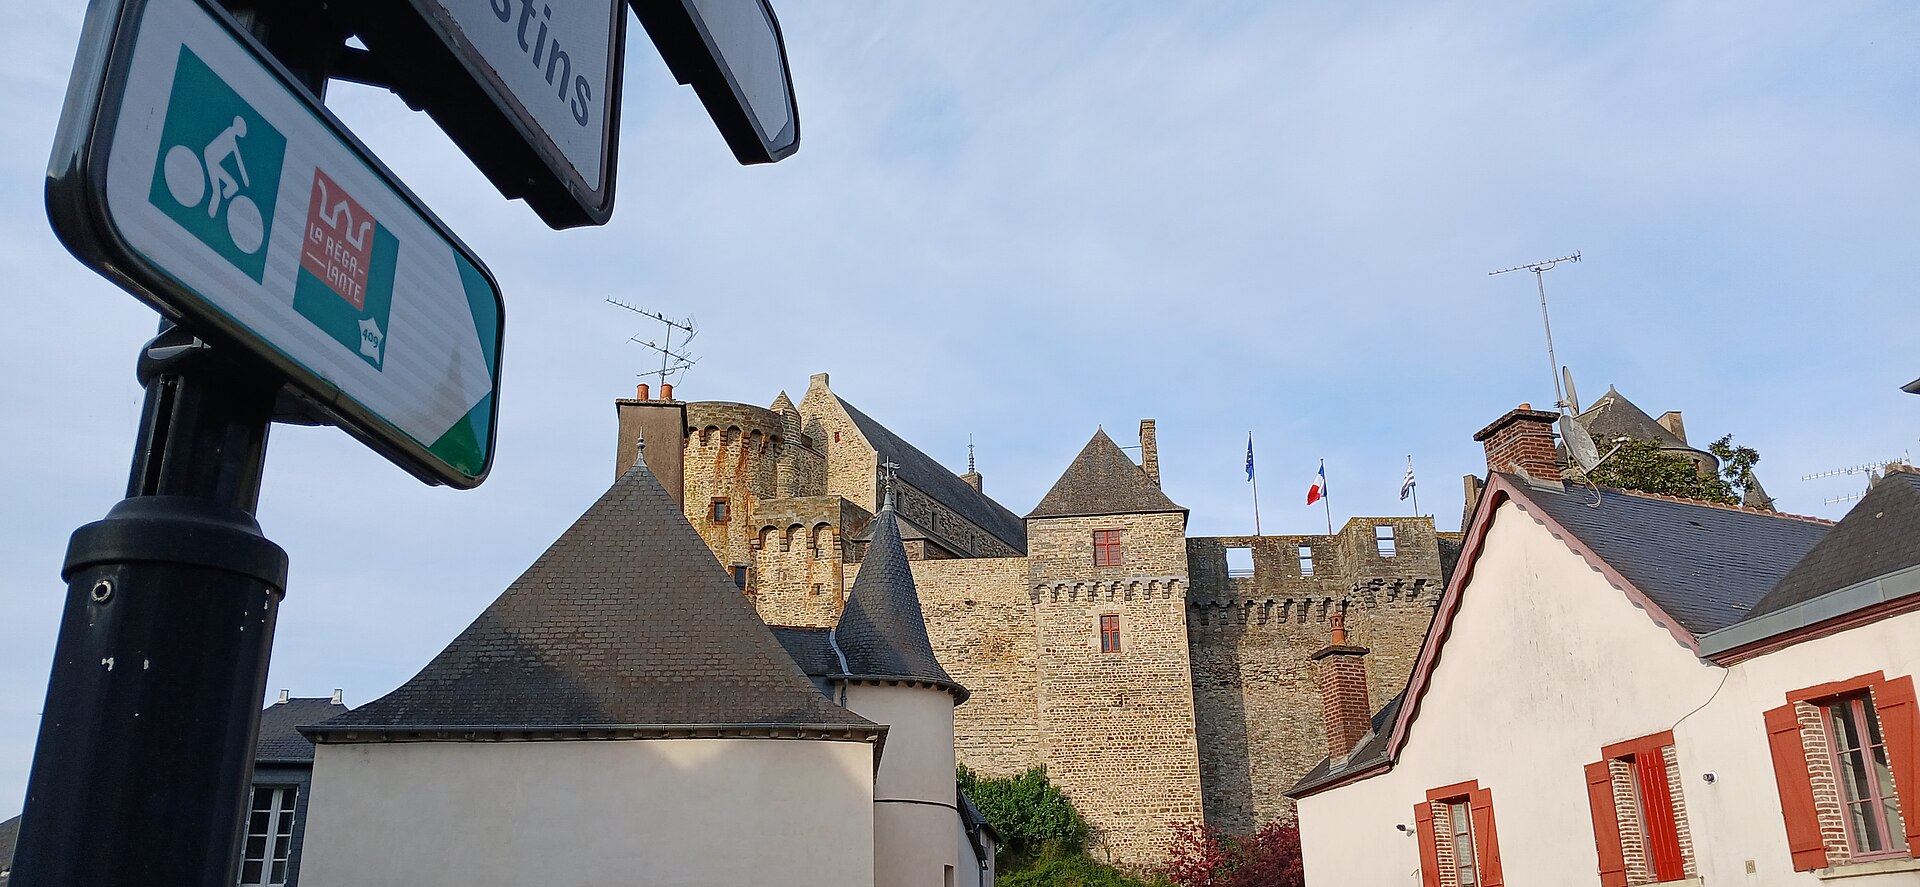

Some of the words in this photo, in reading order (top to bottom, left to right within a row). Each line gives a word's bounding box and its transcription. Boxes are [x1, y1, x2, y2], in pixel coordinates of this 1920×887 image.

[309, 222, 323, 245] LA
[325, 235, 365, 278] RÉGA-
[326, 259, 361, 303] LANTE
[362, 328, 379, 349] 409
